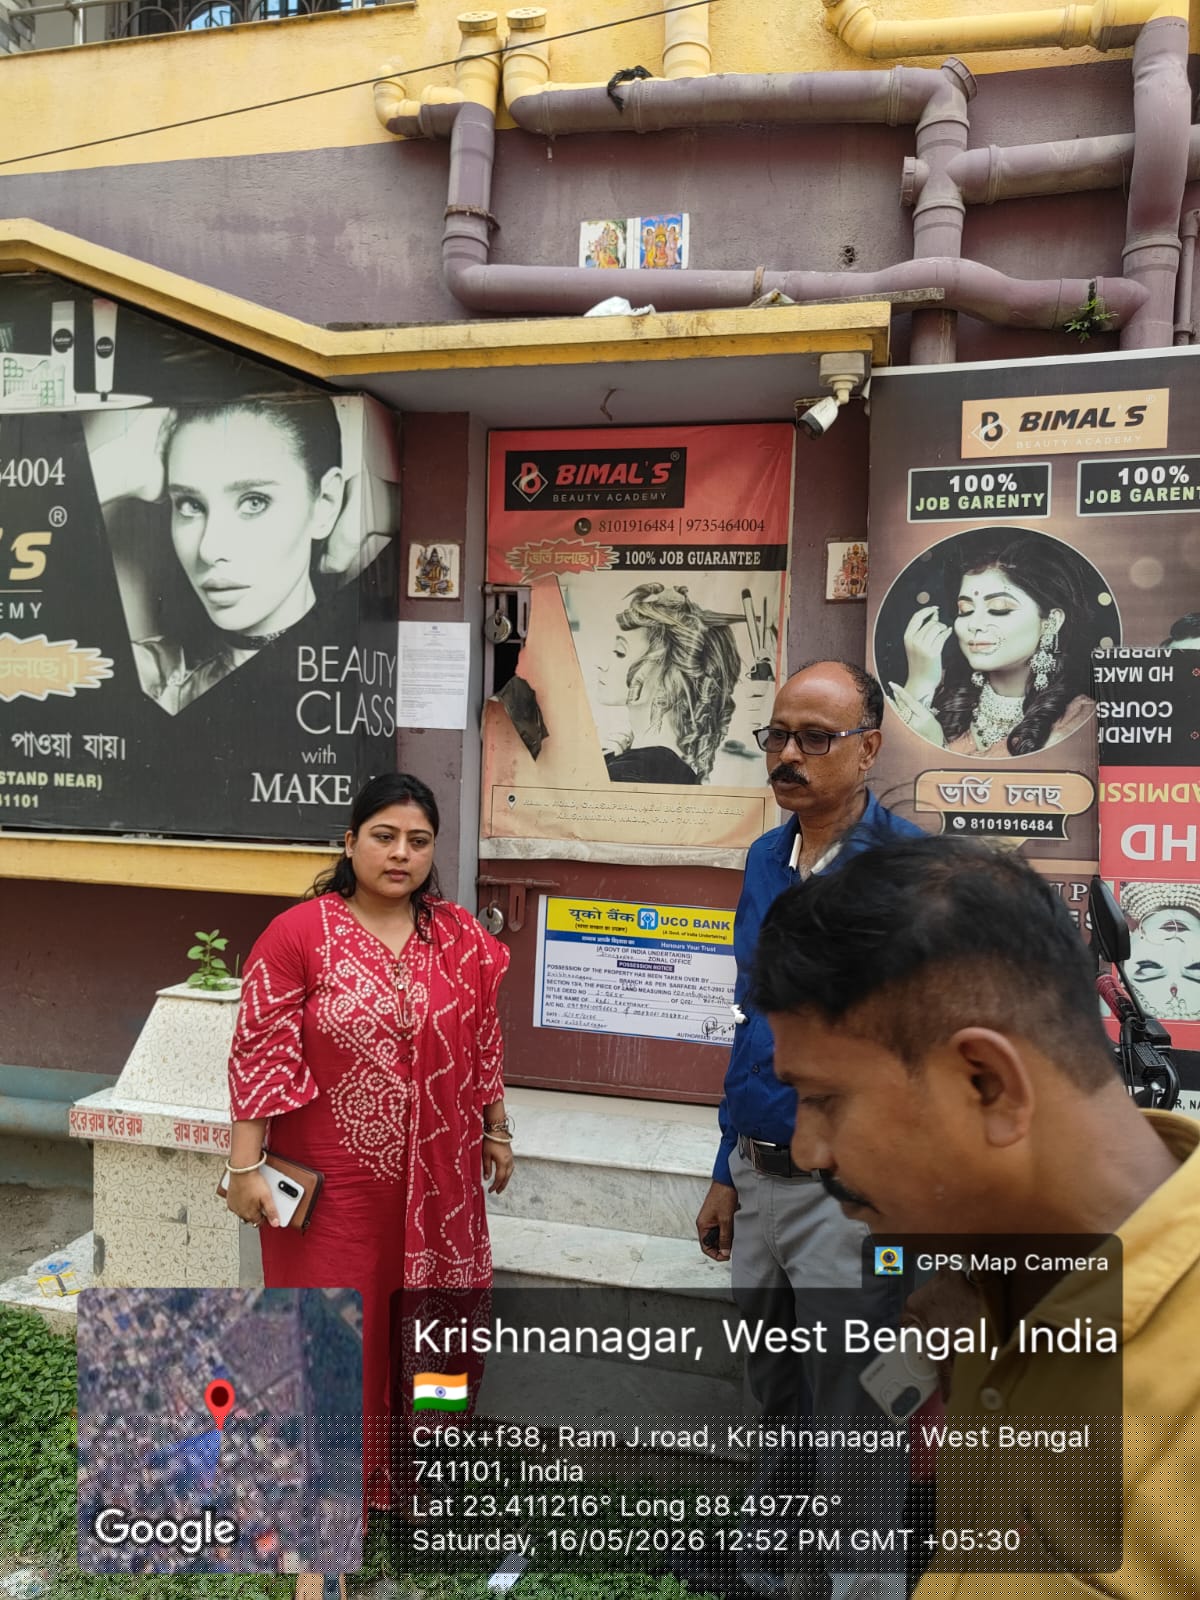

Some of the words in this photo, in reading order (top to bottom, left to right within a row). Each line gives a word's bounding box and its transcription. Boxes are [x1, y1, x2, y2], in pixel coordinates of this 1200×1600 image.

[1016, 438, 1069, 449] BEAUTY
[1075, 435, 1143, 447] ACADEMY
[555, 461, 673, 486] BIMAL'S
[1118, 465, 1190, 485] 100%
[949, 473, 1018, 493] 100%
[552, 493, 600, 503] BEAUTY
[606, 491, 668, 503] ACADEMY
[915, 497, 949, 512] JOB
[958, 493, 1045, 510] GARENTY
[1085, 489, 1121, 505] JOB
[599, 518, 675, 533] 8101916484
[686, 518, 765, 532] 9735464004
[625, 551, 656, 566] 100%
[659, 551, 683, 565] JOB
[687, 551, 761, 566] GUARANTEE
[298, 646, 397, 689] BEAUTY
[1094, 666, 1143, 682] MAKE
[1148, 666, 1174, 682] HD
[296, 690, 395, 737] CLASS
[1096, 701, 1173, 718] COURS
[301, 744, 337, 764] with
[53, 772, 103, 791] NEAR)
[251, 772, 353, 805] MAKE
[0, 793, 39, 808] 1101
[970, 818, 1054, 831] 8101916484
[1121, 824, 1197, 862] HD
[568, 907, 602, 922] यूको
[606, 908, 635, 922] बैंक
[661, 916, 688, 927] UCO
[693, 919, 731, 931] BANK
[547, 964, 581, 972] POSSESSION
[604, 968, 633, 977] PROPERTY
[619, 961, 652, 969] POSSESSION
